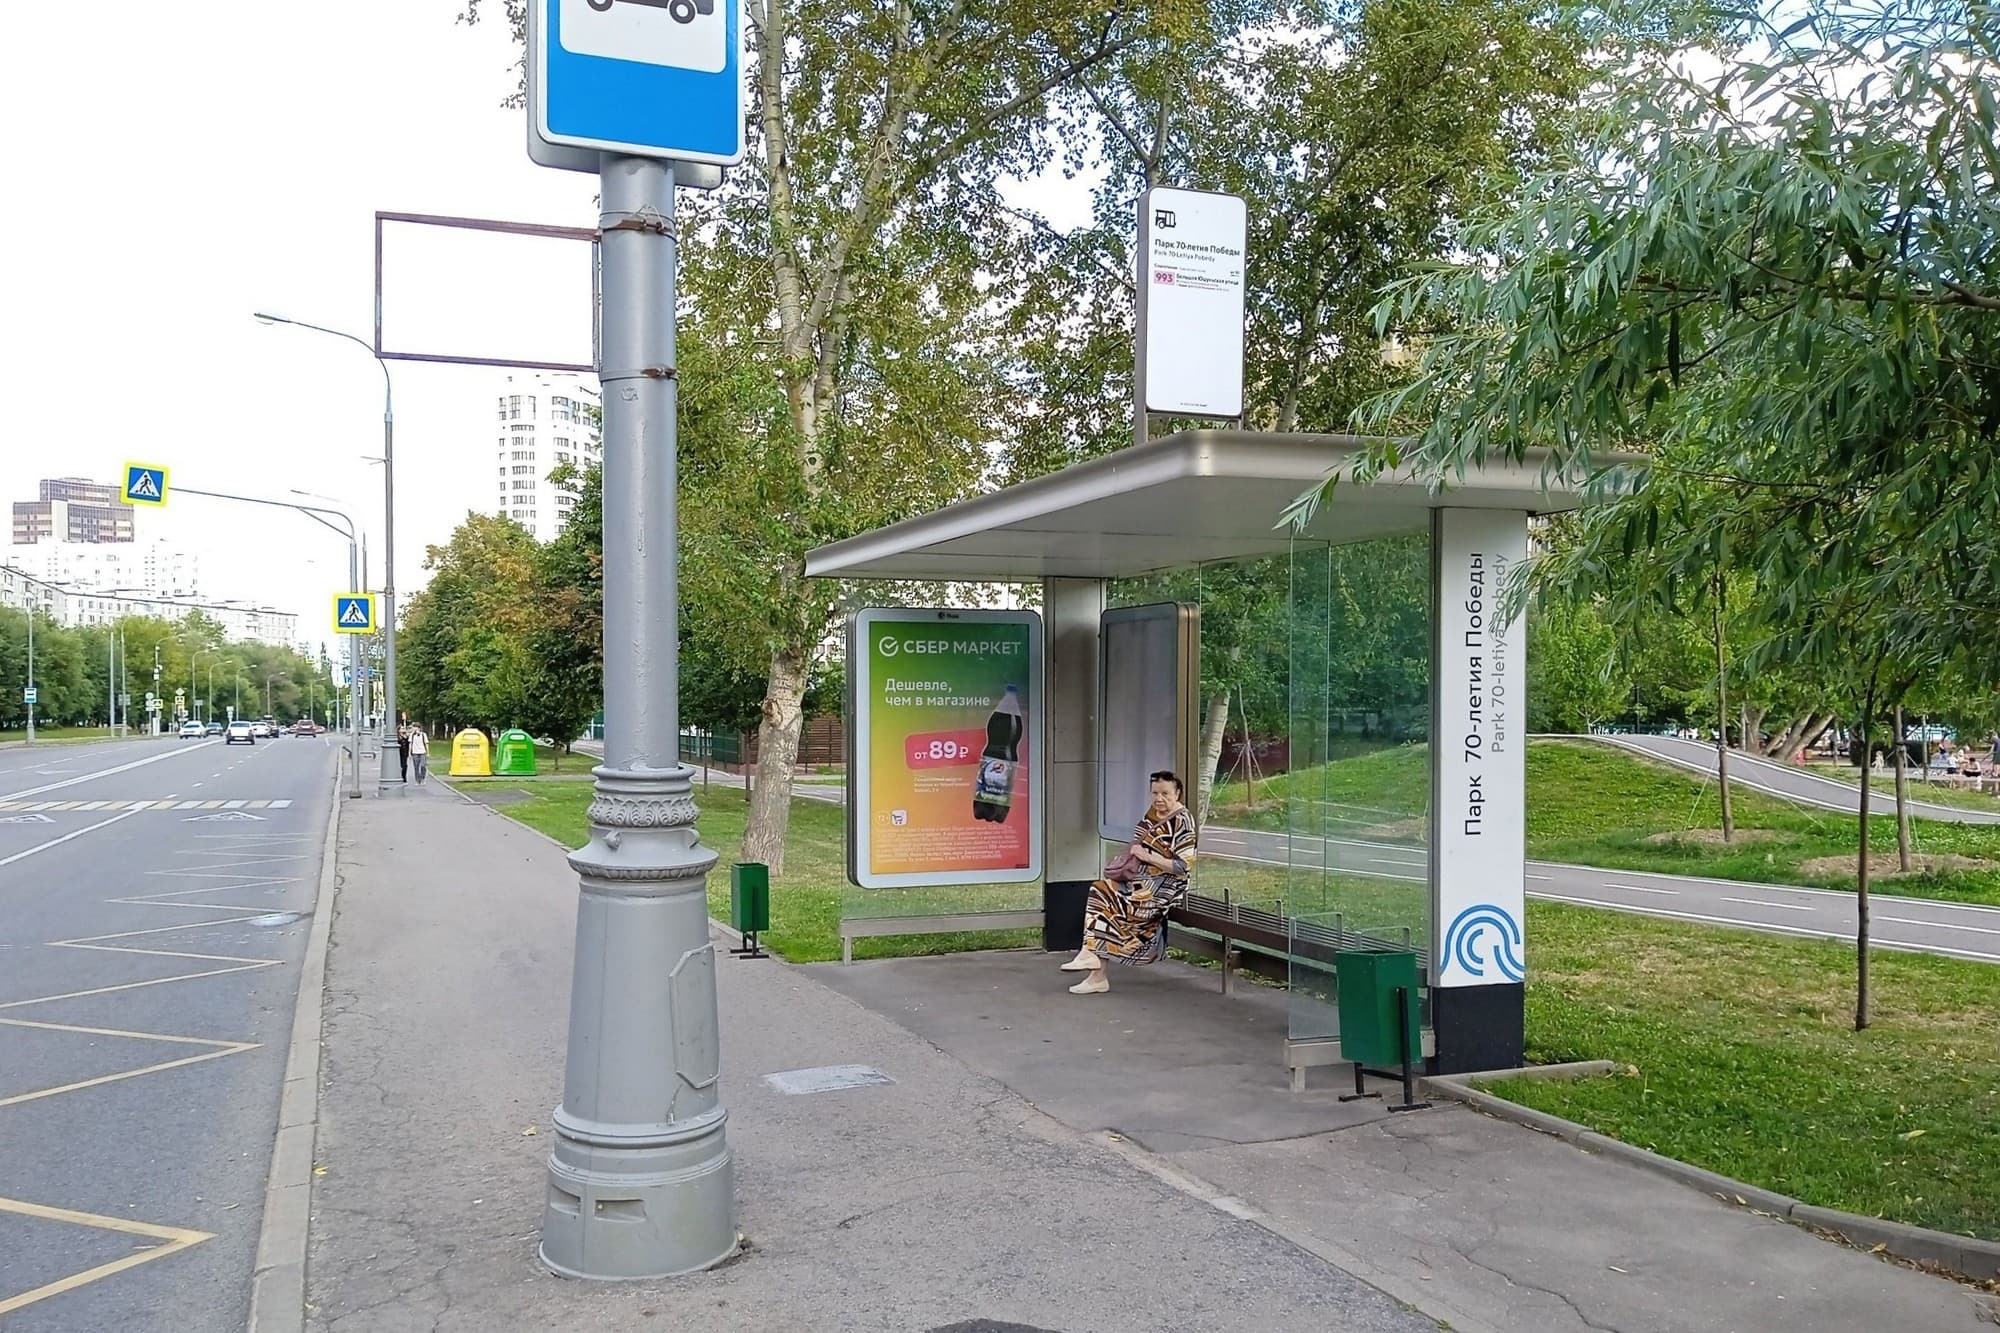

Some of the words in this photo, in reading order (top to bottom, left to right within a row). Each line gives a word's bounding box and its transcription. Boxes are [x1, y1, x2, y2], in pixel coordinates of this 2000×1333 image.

[1155, 239, 1175, 249] Парк
[1175, 241, 1209, 252] 70-летия
[1210, 245, 1240, 256] Победы
[1155, 272, 1173, 283] 993
[1465, 553, 1485, 647] Победы
[903, 640, 949, 654] СБЕР
[953, 641, 1021, 654] МАРКЕТ
[884, 678, 952, 693] Дешевле,
[885, 696, 911, 706] чем
[915, 696, 923, 706] в
[927, 696, 990, 706] магазине
[1465, 656, 1483, 763] 70-летия
[1491, 713, 1505, 753] Park
[914, 751, 928, 760] от
[929, 740, 957, 760] 89
[1465, 775, 1486, 836] Парк
